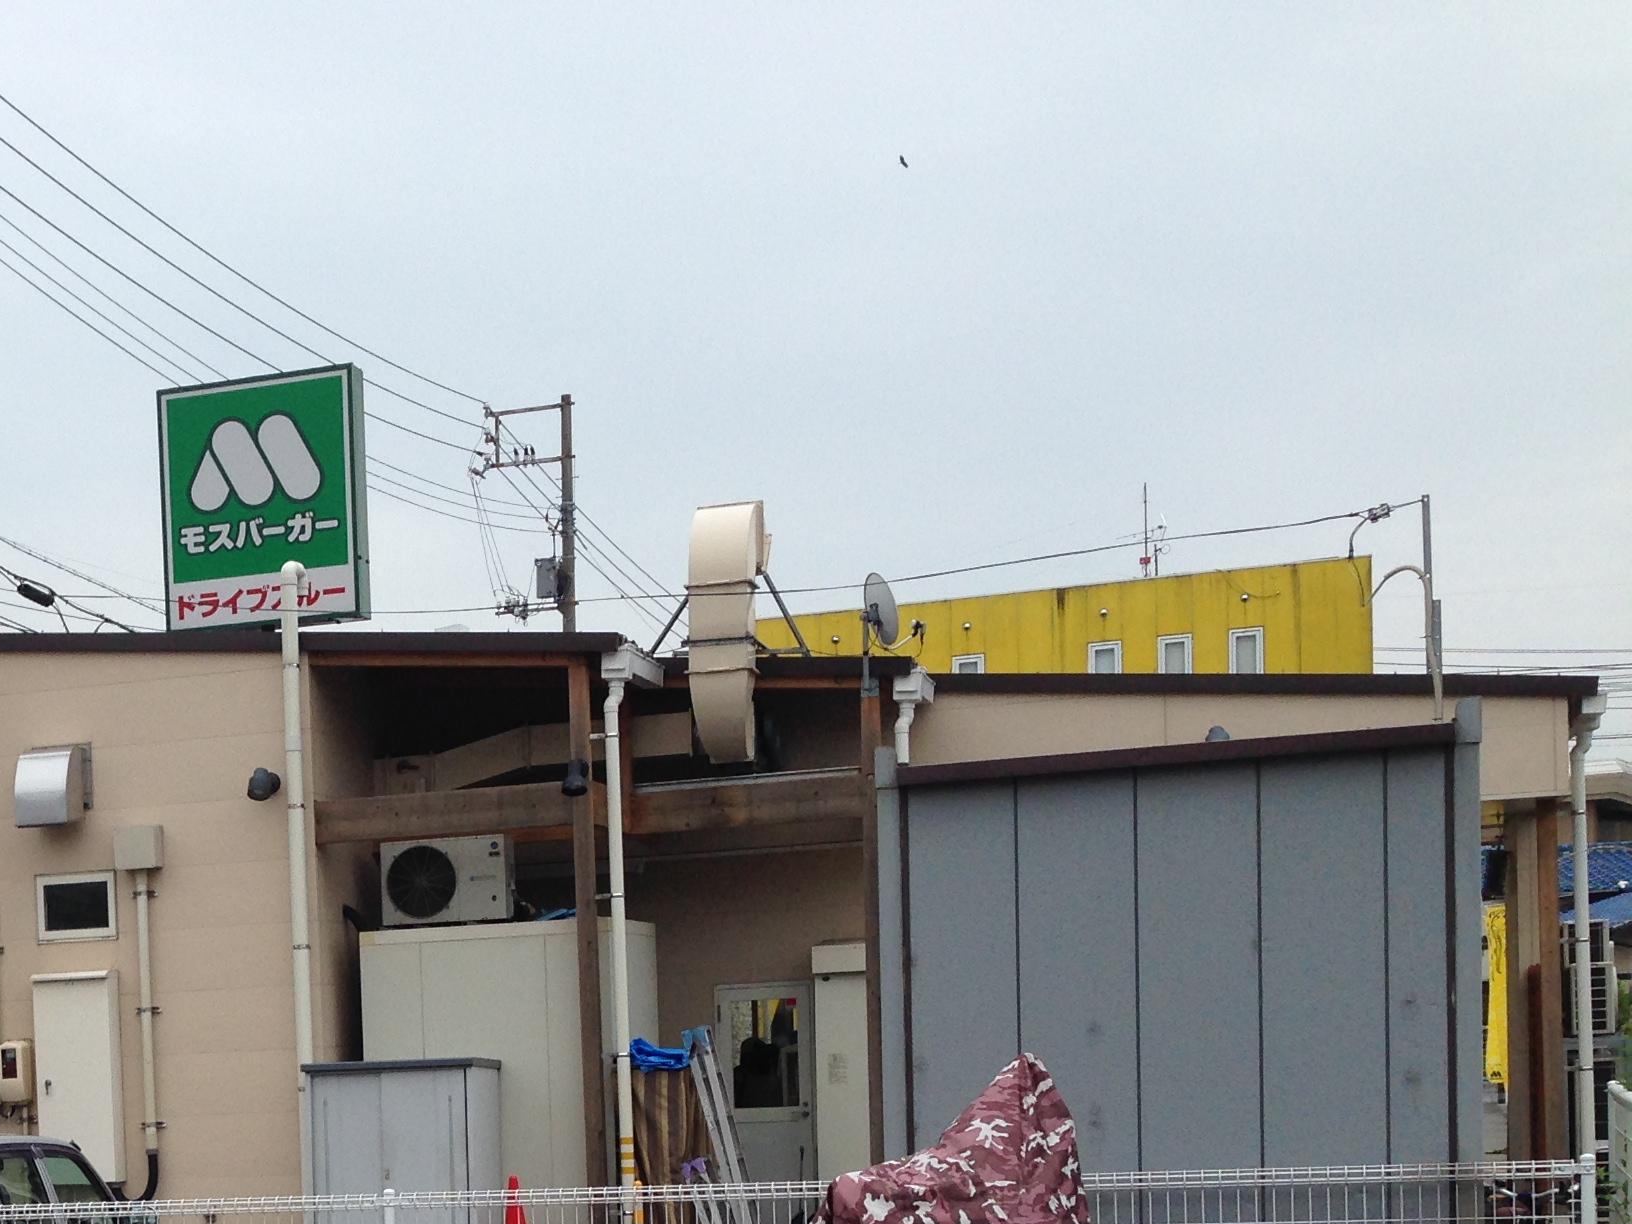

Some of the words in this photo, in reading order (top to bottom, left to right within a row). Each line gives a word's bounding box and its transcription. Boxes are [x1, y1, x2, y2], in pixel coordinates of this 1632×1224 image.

[179, 513, 339, 555] モスバーガー
